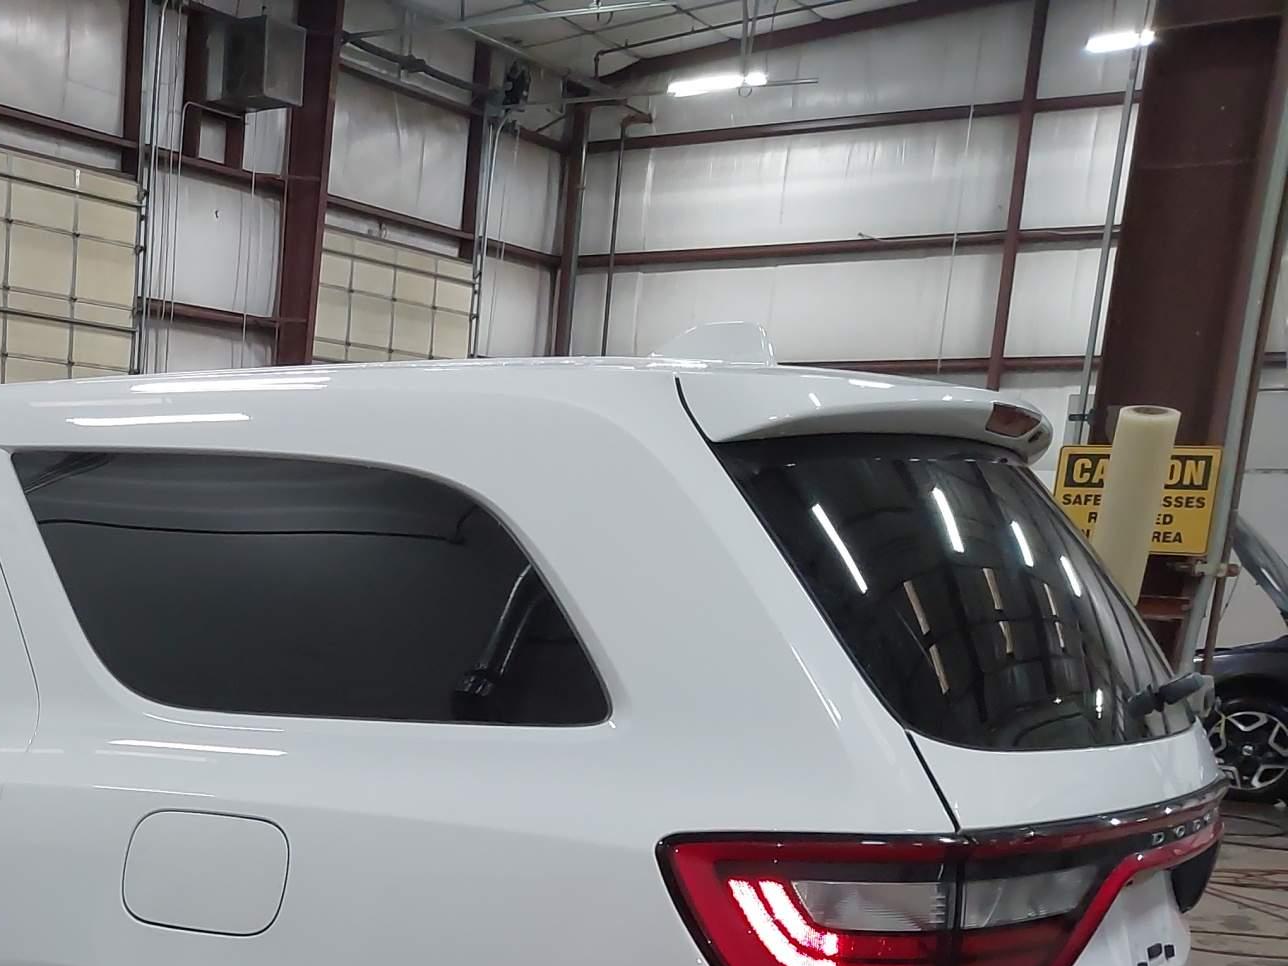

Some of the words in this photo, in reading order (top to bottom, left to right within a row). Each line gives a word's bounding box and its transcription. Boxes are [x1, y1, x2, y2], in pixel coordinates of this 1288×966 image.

[1062, 493, 1102, 506] SAFE
[1163, 496, 1206, 509] SSES
[1152, 531, 1182, 543] REA
